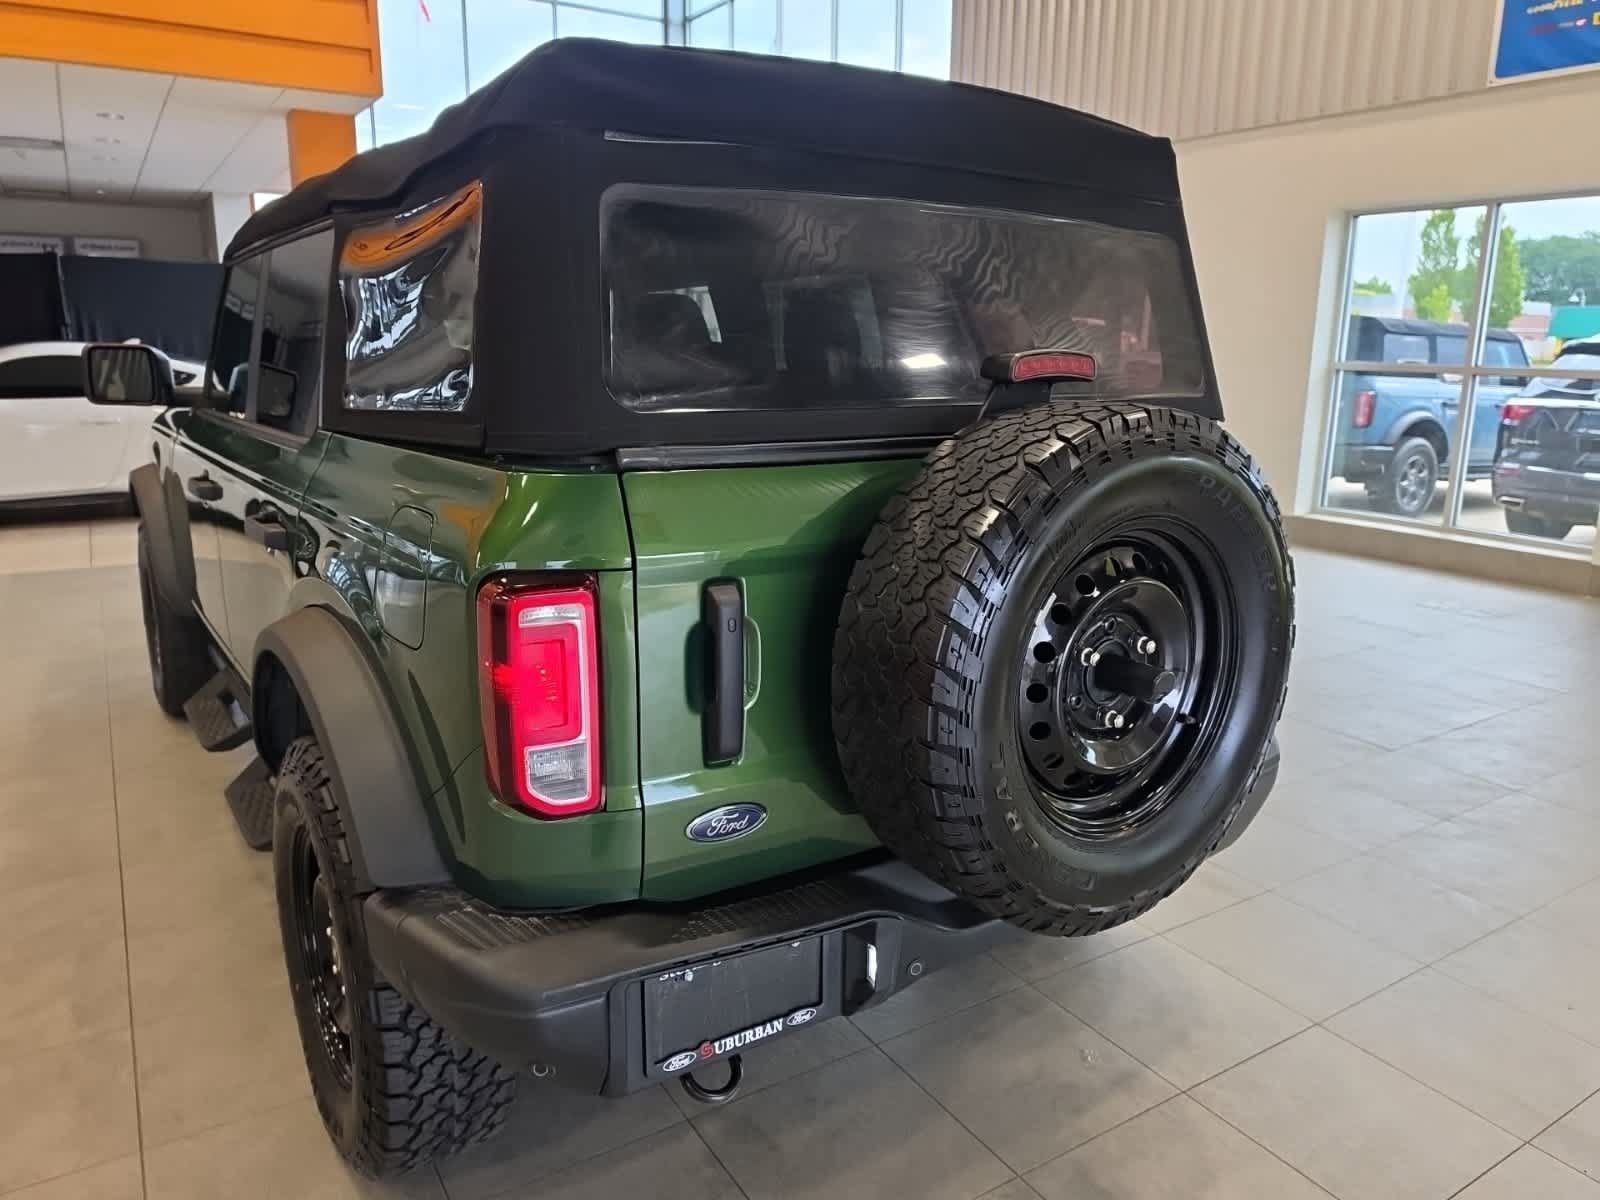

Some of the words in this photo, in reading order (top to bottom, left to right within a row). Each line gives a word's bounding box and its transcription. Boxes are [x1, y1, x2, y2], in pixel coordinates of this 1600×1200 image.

[706, 812, 750, 837] Ford
[668, 1055, 691, 1070] Ford
[700, 1017, 785, 1060] SUBURBAN
[791, 1010, 812, 1025] Ford
